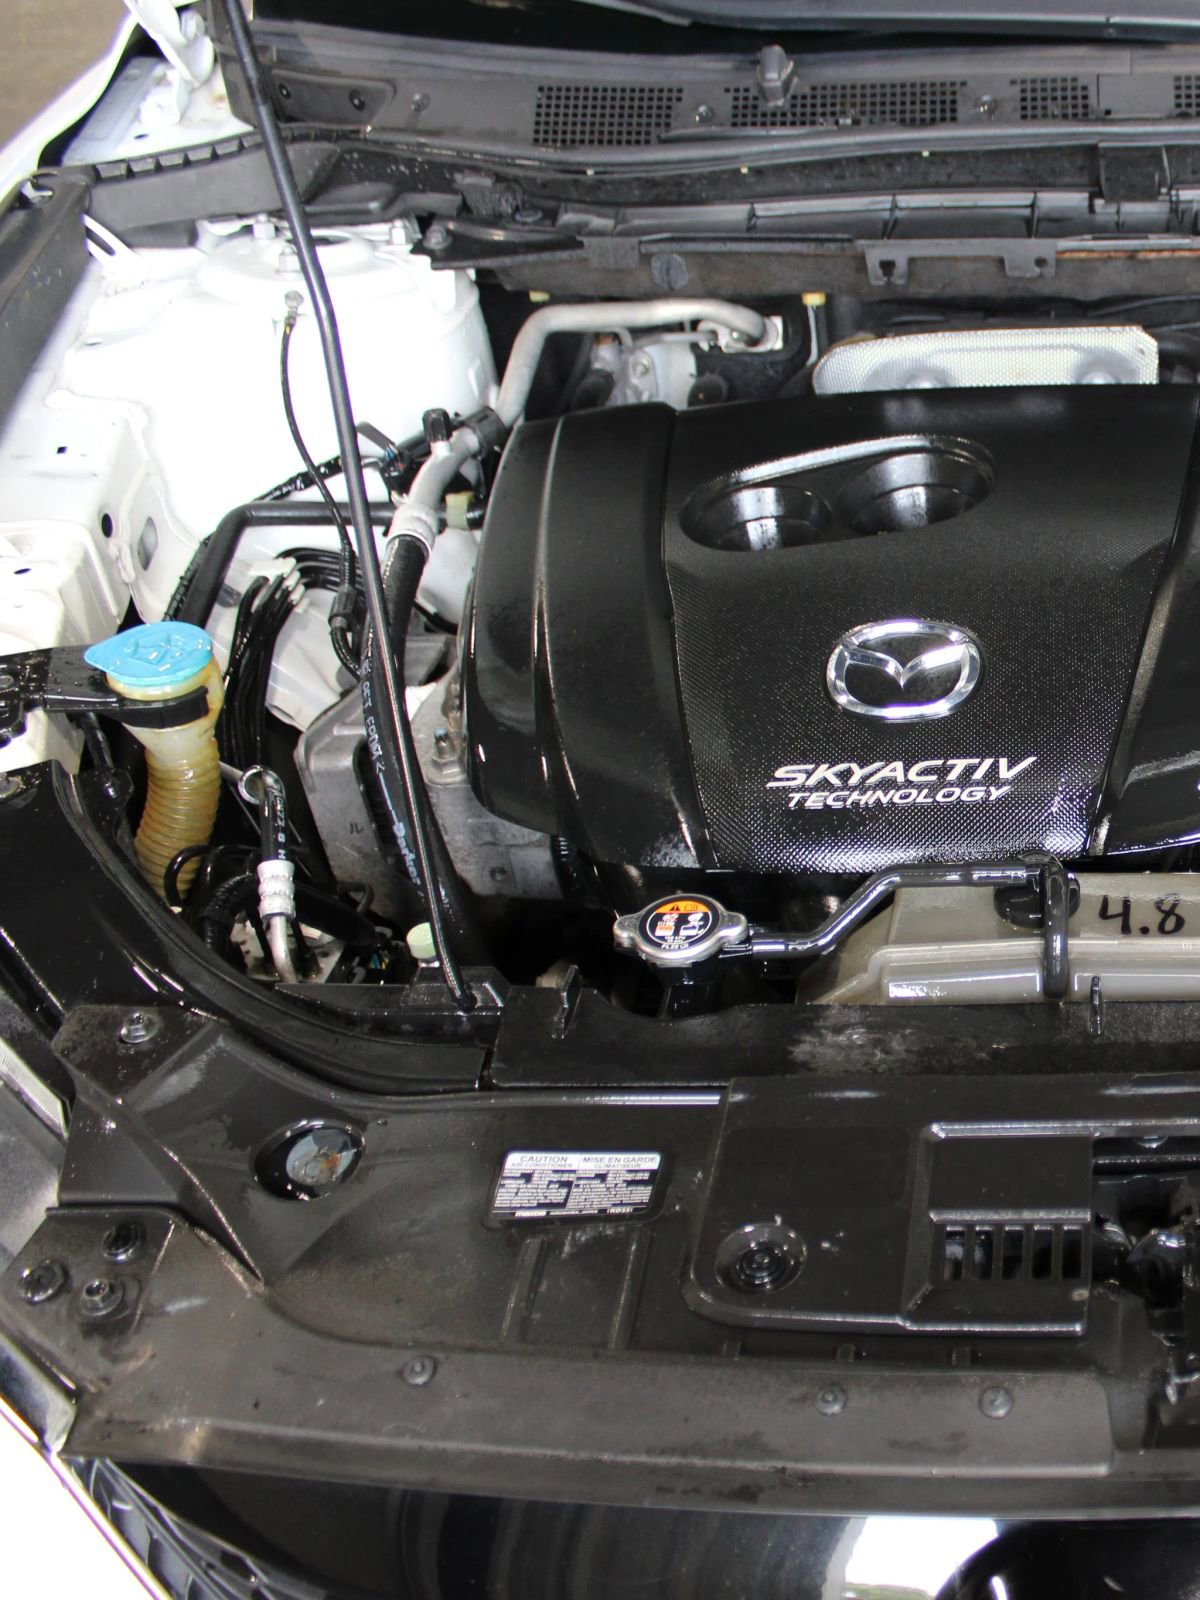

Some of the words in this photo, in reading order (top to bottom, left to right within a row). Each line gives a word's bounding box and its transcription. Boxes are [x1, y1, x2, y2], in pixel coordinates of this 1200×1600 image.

[766, 757, 1038, 788] SKYACTIV
[787, 785, 1014, 810] TECHNOLOGY
[393, 821, 421, 886] Parker
[1098, 893, 1186, 936] 4.8
[520, 1155, 568, 1163] CAUTION
